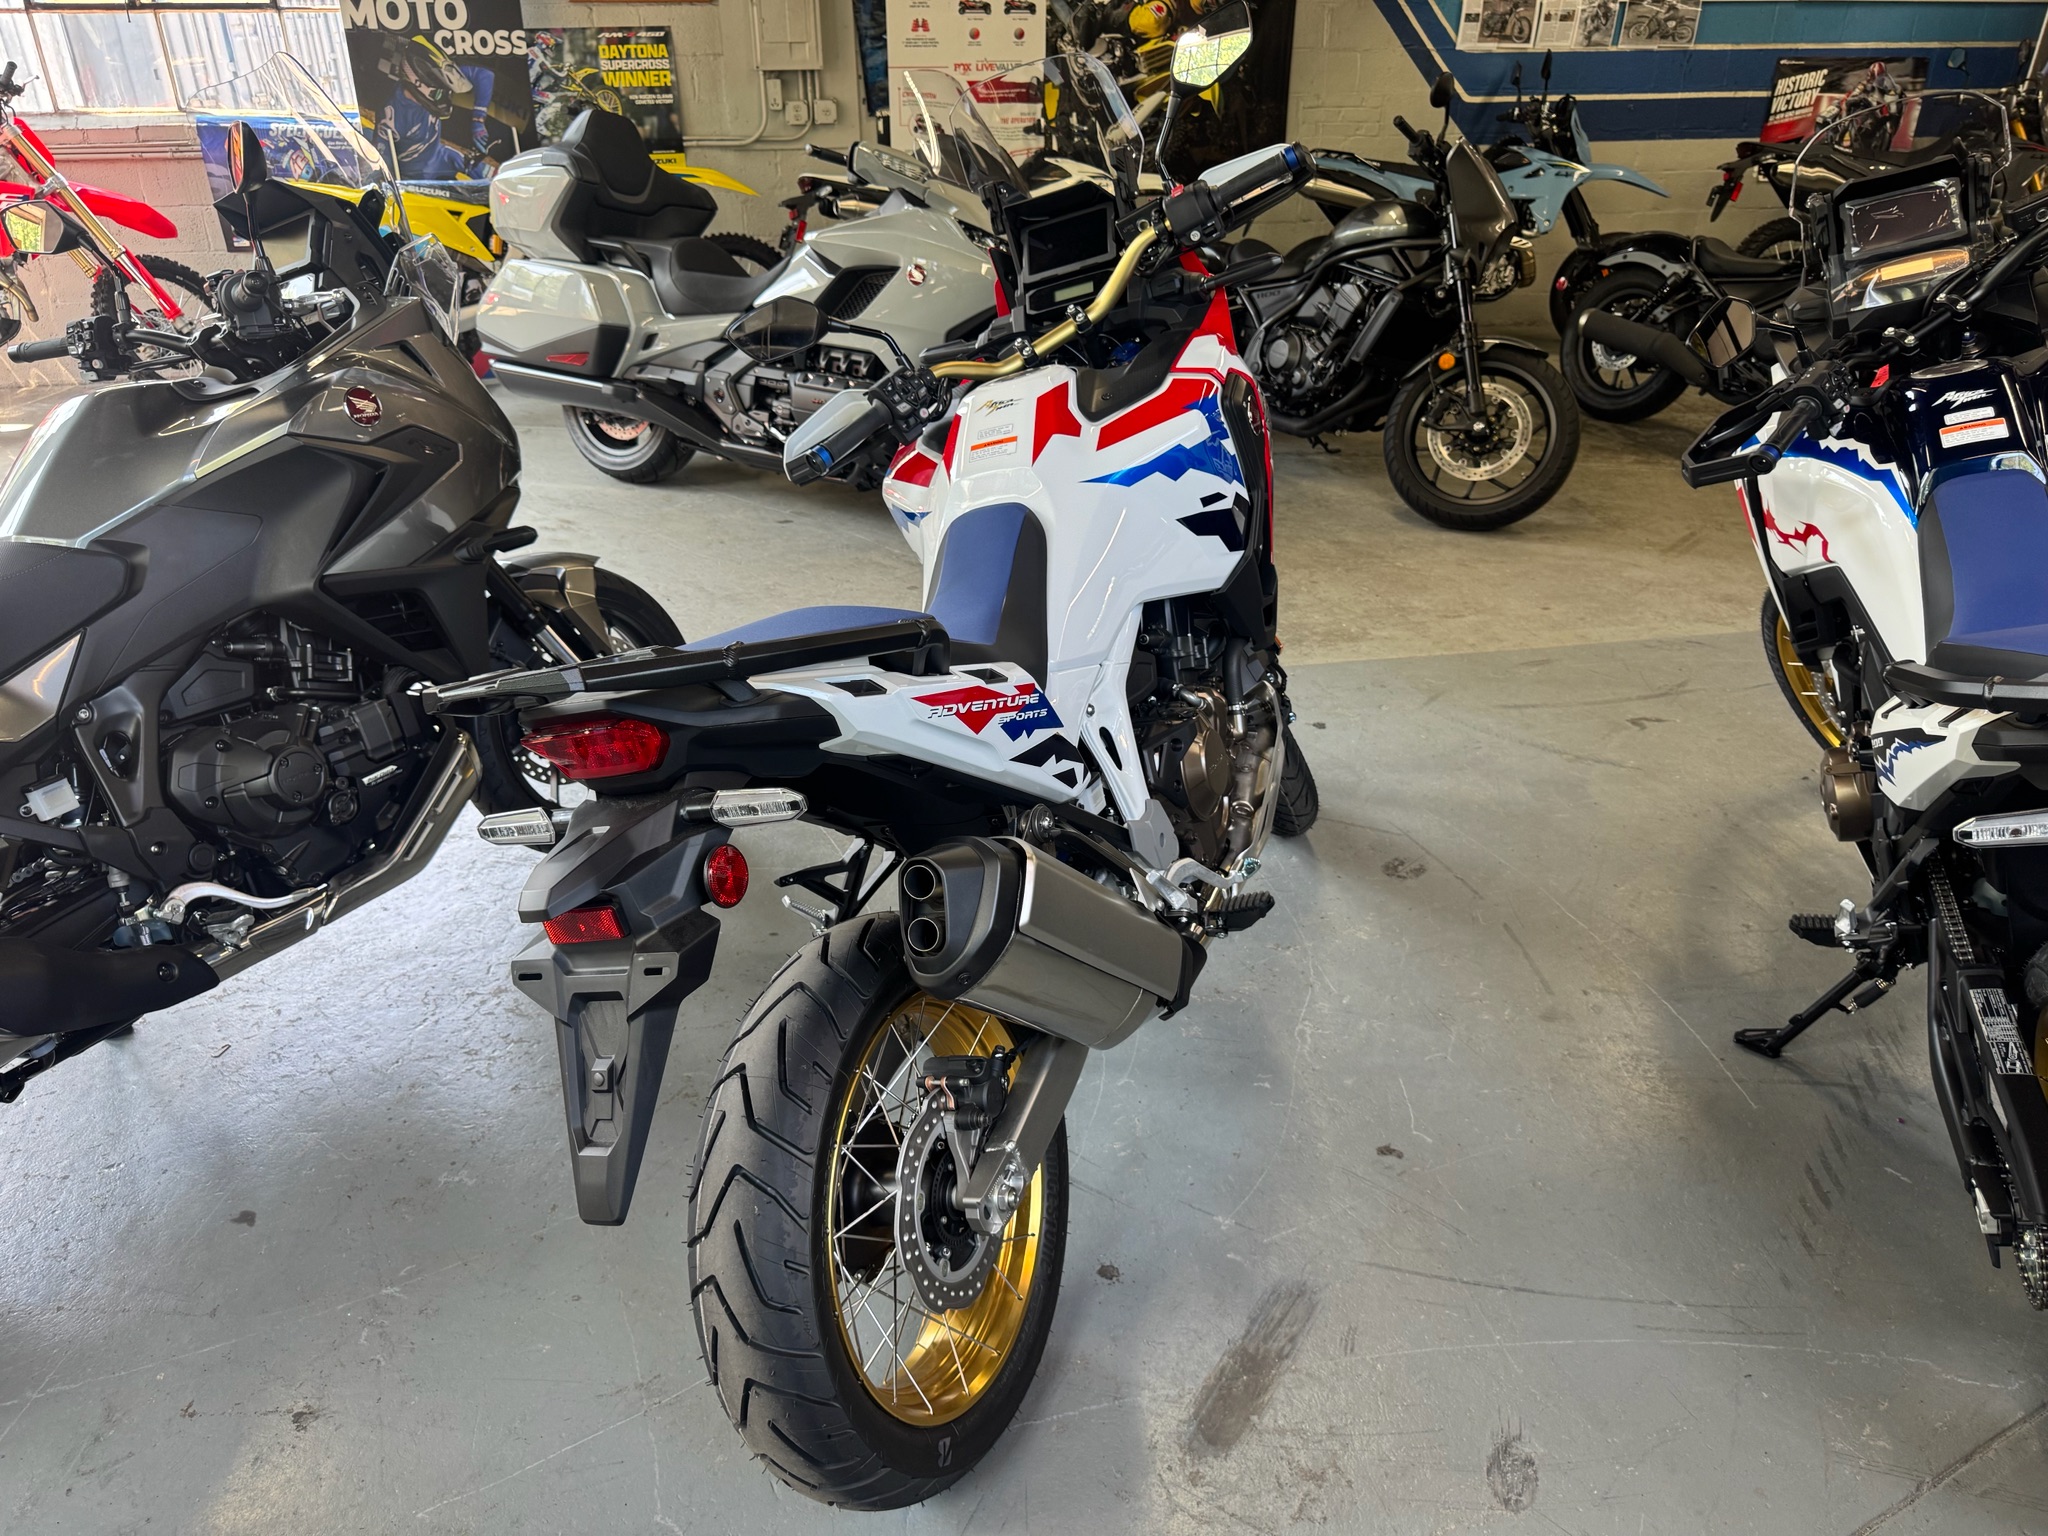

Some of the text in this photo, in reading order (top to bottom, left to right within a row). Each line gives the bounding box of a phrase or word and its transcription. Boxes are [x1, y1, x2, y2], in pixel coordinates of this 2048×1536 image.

[341, 0, 468, 31] MOTO
[433, 29, 528, 56] CROSS
[598, 44, 669, 59] DAYTONA
[600, 59, 671, 71] SUPERCROSS
[602, 71, 672, 88] WINNER
[1774, 69, 1828, 97] HISTORIC
[1770, 87, 1821, 114] VICTORY
[407, 185, 451, 198] SUZUKI
[927, 693, 1040, 719] ADVENTURE
[998, 708, 1048, 726] SPORTS
